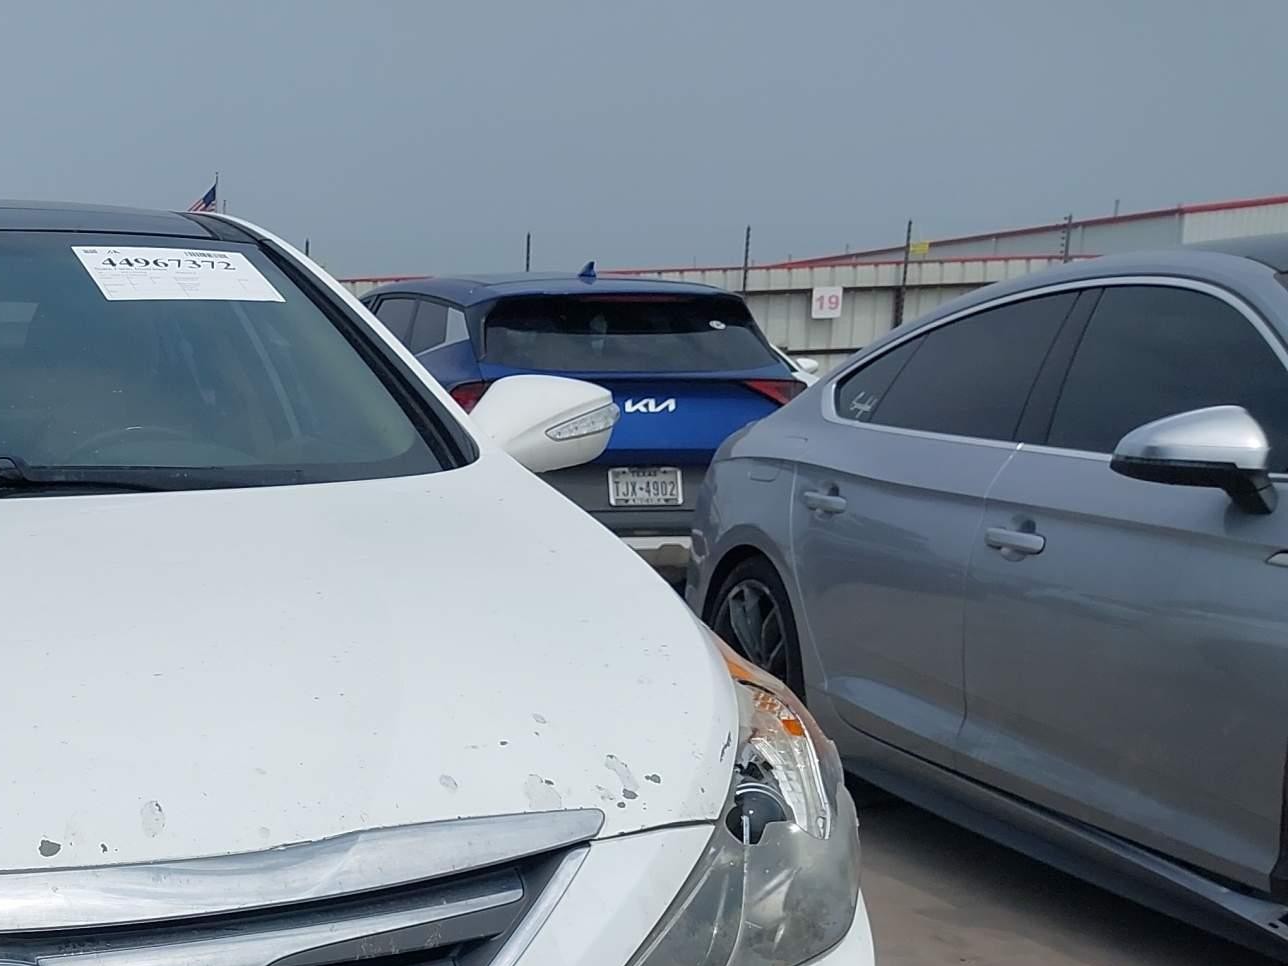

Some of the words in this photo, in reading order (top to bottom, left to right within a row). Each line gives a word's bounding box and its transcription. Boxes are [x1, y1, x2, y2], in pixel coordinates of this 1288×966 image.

[101, 256, 237, 271] 44967372
[816, 295, 840, 310] 19
[624, 398, 676, 413] KIA
